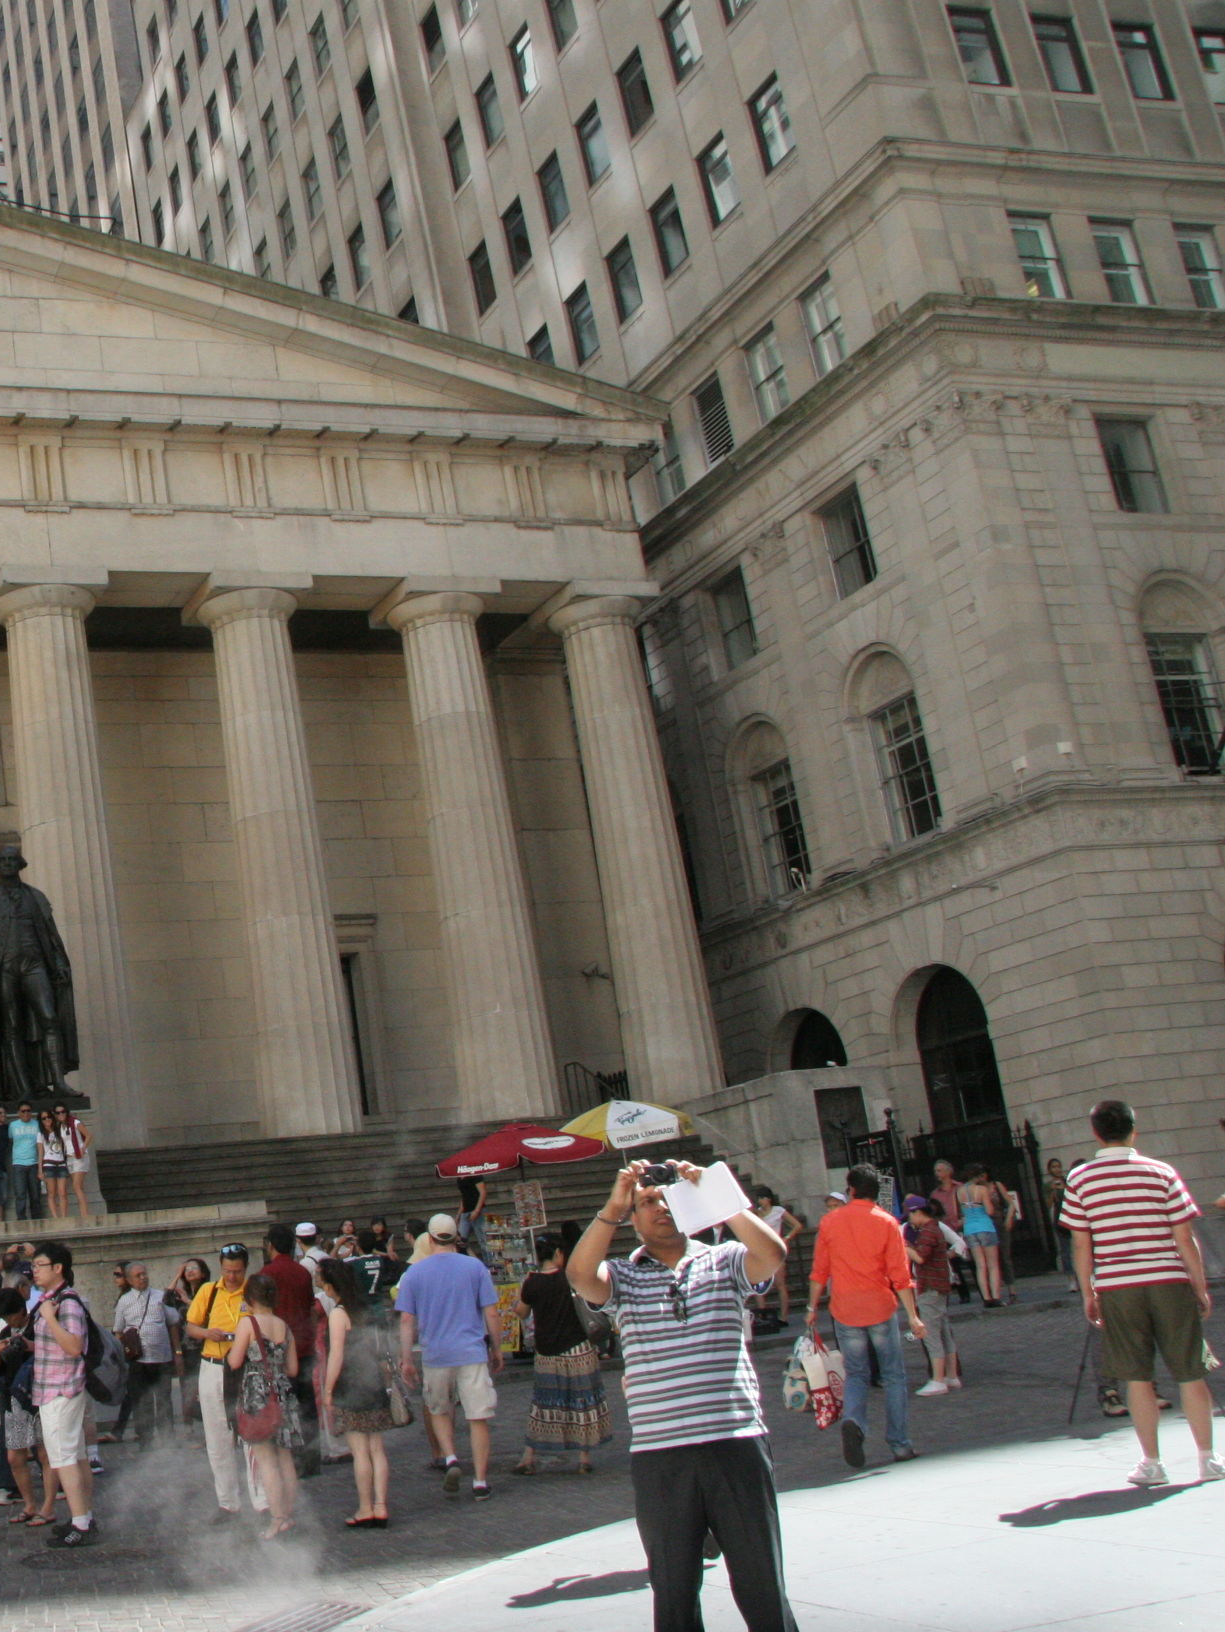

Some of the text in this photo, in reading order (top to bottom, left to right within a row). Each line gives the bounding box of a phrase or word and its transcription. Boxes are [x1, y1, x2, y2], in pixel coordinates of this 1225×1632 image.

[617, 1127, 674, 1144] FROZEN LEMONADE
[367, 1269, 380, 1294] 7
